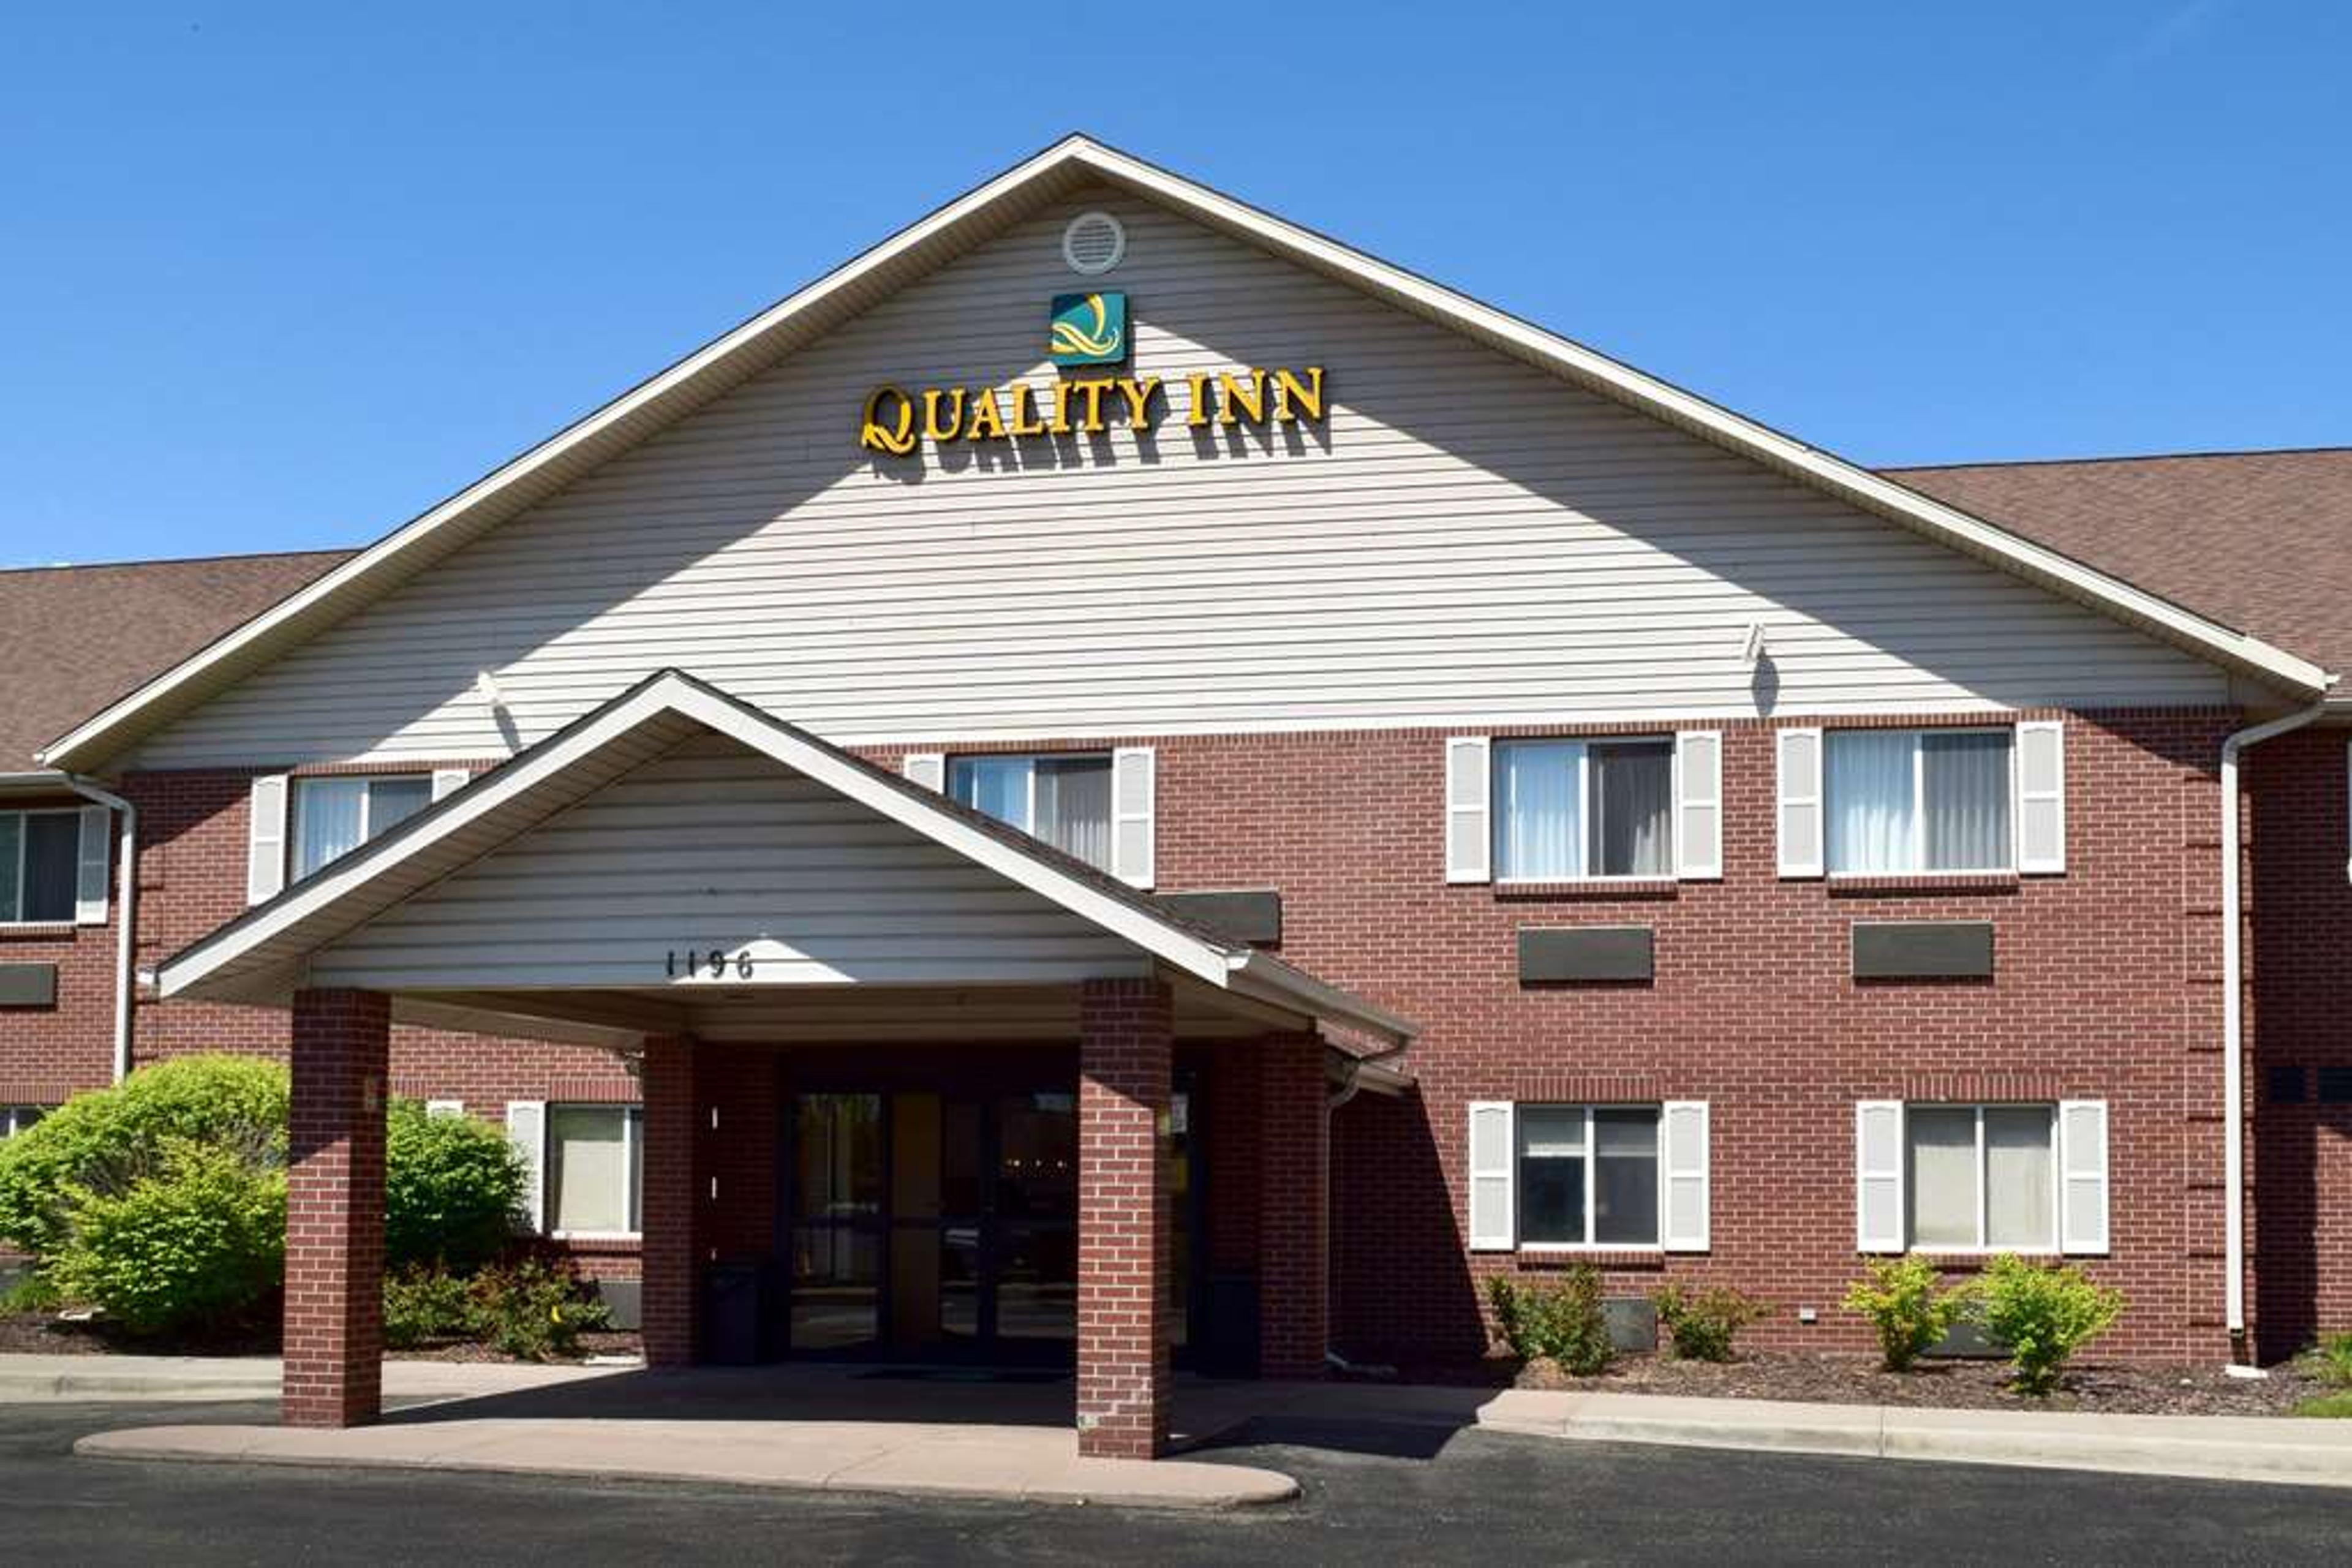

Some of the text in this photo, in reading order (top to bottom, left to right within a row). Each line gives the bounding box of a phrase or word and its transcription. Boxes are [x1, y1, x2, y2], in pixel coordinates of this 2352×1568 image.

[861, 368, 1326, 455] QUALITY INN
[667, 950, 753, 978] 1196
